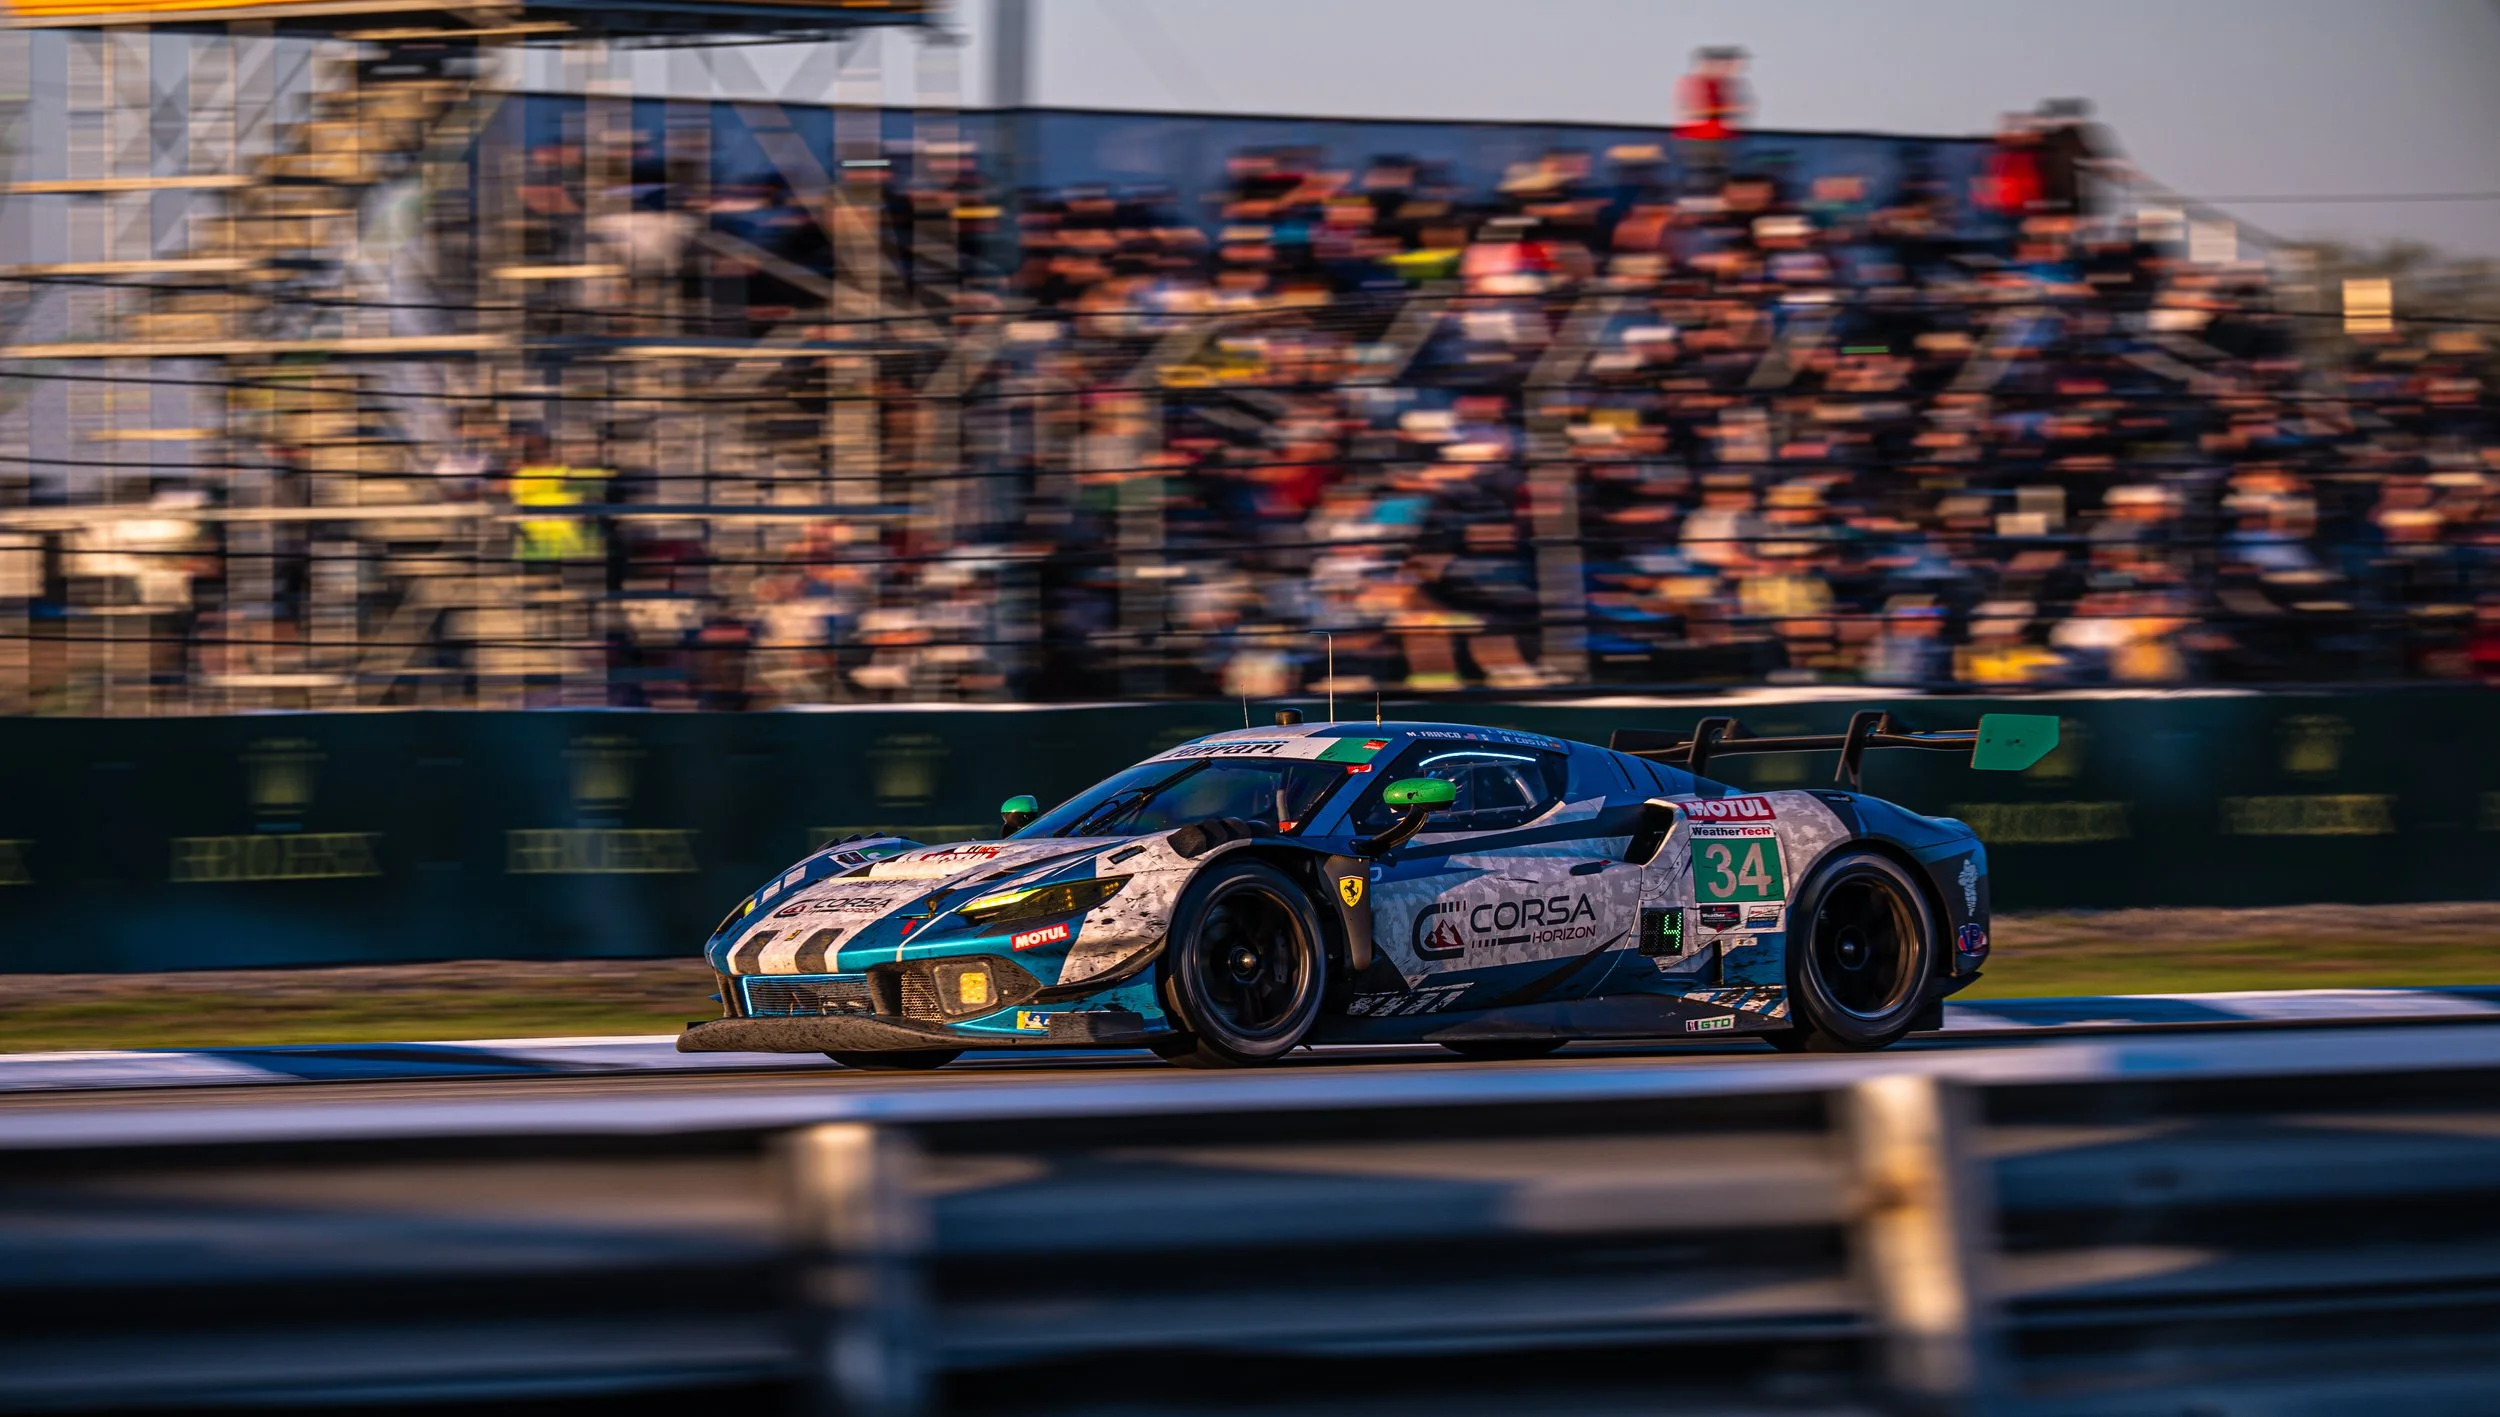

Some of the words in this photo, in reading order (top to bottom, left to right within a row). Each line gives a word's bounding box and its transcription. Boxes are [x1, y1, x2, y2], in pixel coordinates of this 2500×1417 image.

[1420, 731, 1462, 739] FRANCO
[1514, 737, 1549, 748] COSTA
[1684, 799, 1770, 817] MOTUL
[1692, 827, 1771, 836] WeatherTech
[1705, 842, 1772, 898] 34
[814, 897, 893, 909] CORSA
[1470, 893, 1596, 933] CORSA
[1015, 925, 1067, 949] MOTUL
[1532, 925, 1597, 944] HORIZON
[1663, 912, 1682, 948] 4
[1701, 1018, 1731, 1029] GTD
